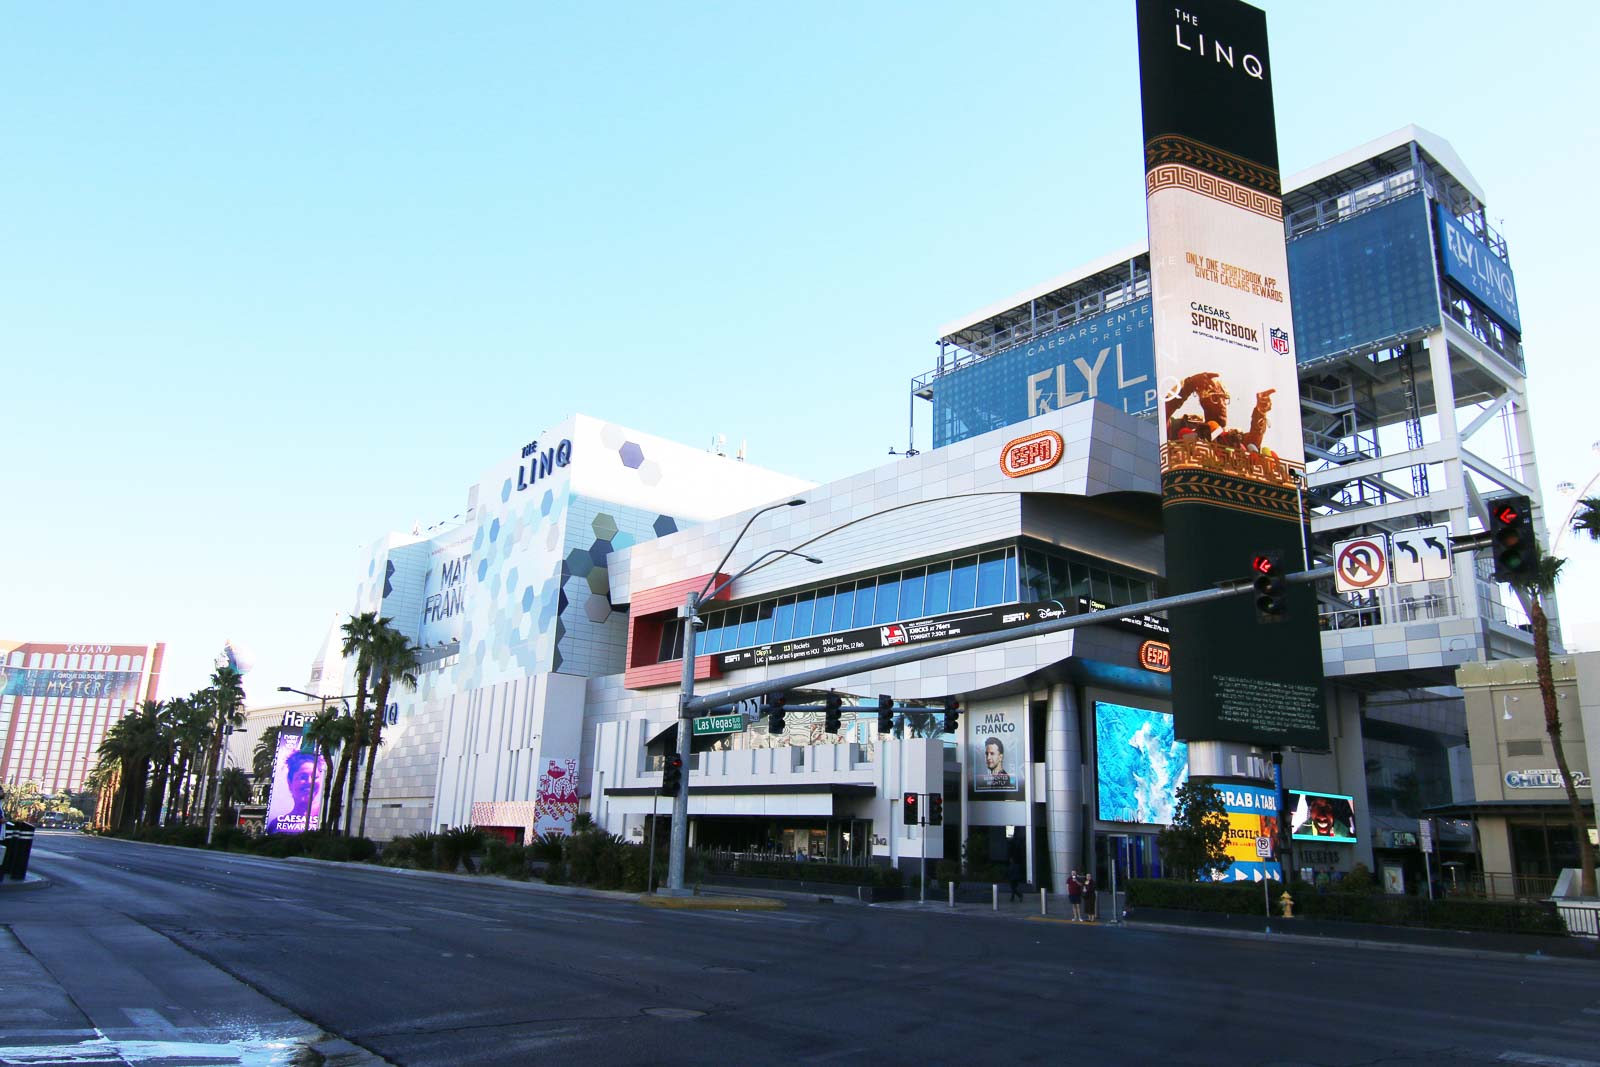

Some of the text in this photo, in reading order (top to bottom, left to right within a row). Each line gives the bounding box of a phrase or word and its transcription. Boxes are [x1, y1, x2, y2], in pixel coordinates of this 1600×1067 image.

[1175, 8, 1198, 26] THE
[1176, 24, 1263, 80] LINQ
[1186, 251, 1277, 289] ONLY ONE SPORTSBOOK APP
[1195, 267, 1283, 303] GIVETH CAESARS REWARDS
[1190, 301, 1231, 320] CAESARS
[1092, 317, 1153, 345] PRESE
[1191, 312, 1259, 343] SPORTSBOOK
[1027, 324, 1098, 357] CAESARS
[1272, 336, 1288, 352] NFL
[521, 440, 538, 459] THE
[1010, 438, 1052, 469] ESPN
[517, 438, 572, 492] LINQ
[440, 553, 472, 592] MAT
[66, 644, 112, 654] ISLAND
[1147, 647, 1169, 666] ESPN
[697, 719, 709, 730] Las
[710, 717, 733, 732] Vegas
[985, 713, 1005, 724] MAT
[975, 723, 1015, 735] FRANCO
[1255, 794, 1261, 809] A
